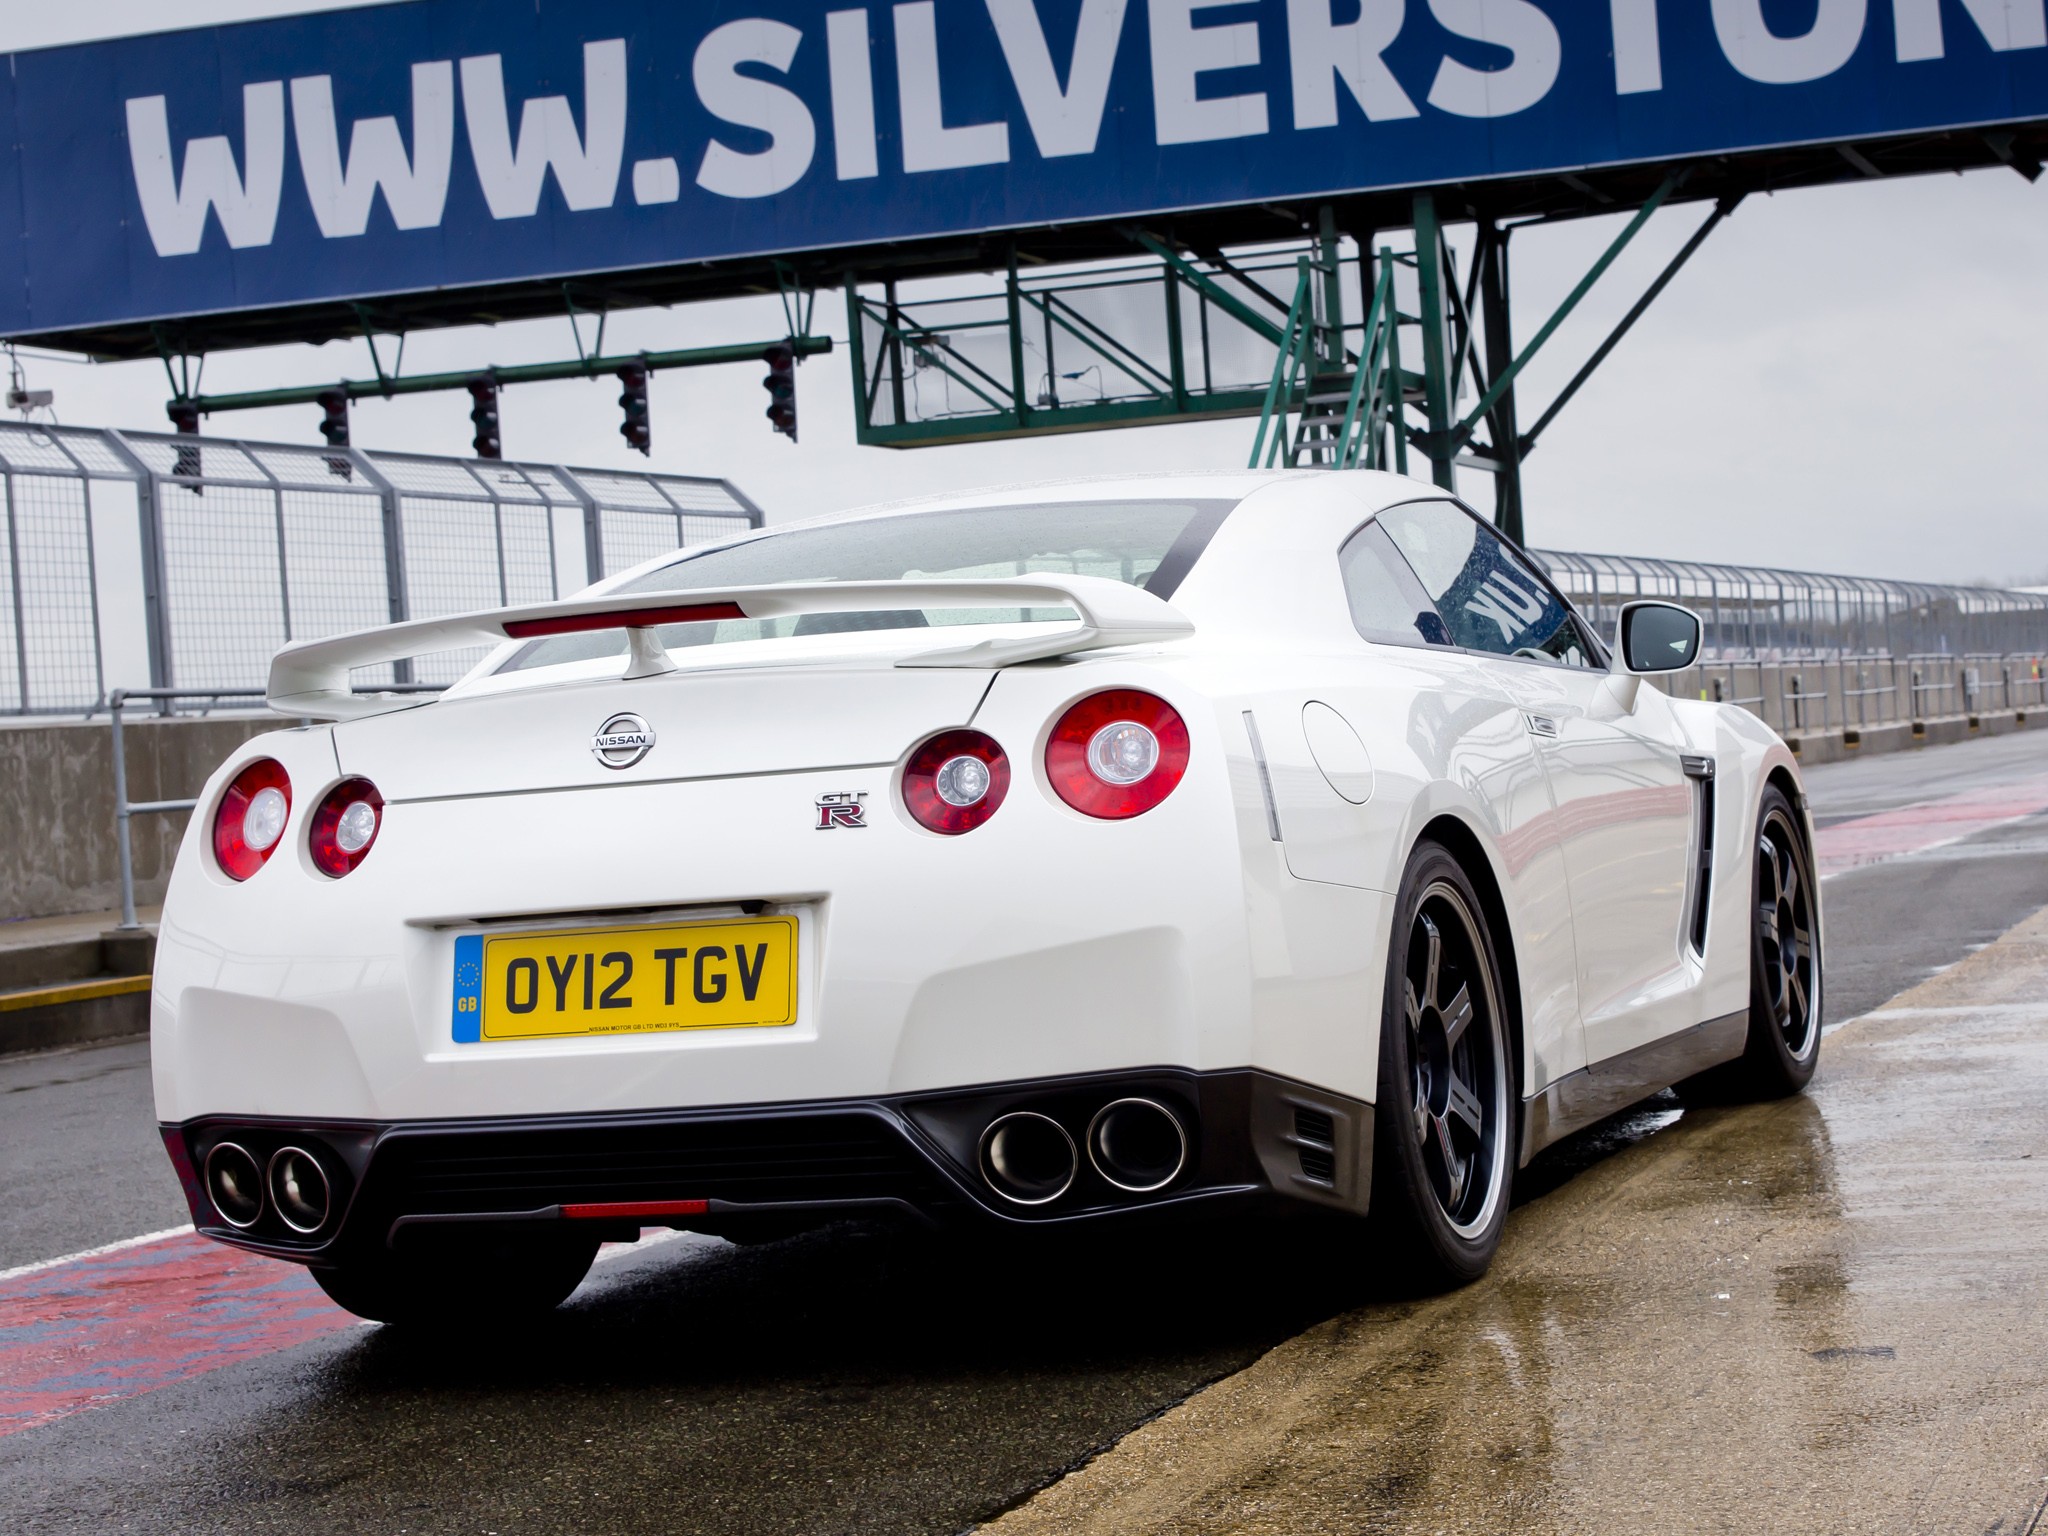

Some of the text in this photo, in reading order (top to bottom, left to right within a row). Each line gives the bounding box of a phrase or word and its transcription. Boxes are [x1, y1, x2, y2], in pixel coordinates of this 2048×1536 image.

[595, 735, 646, 747] NISSAN
[506, 943, 768, 1014] OY12 TGV
[458, 996, 477, 1012] GB
